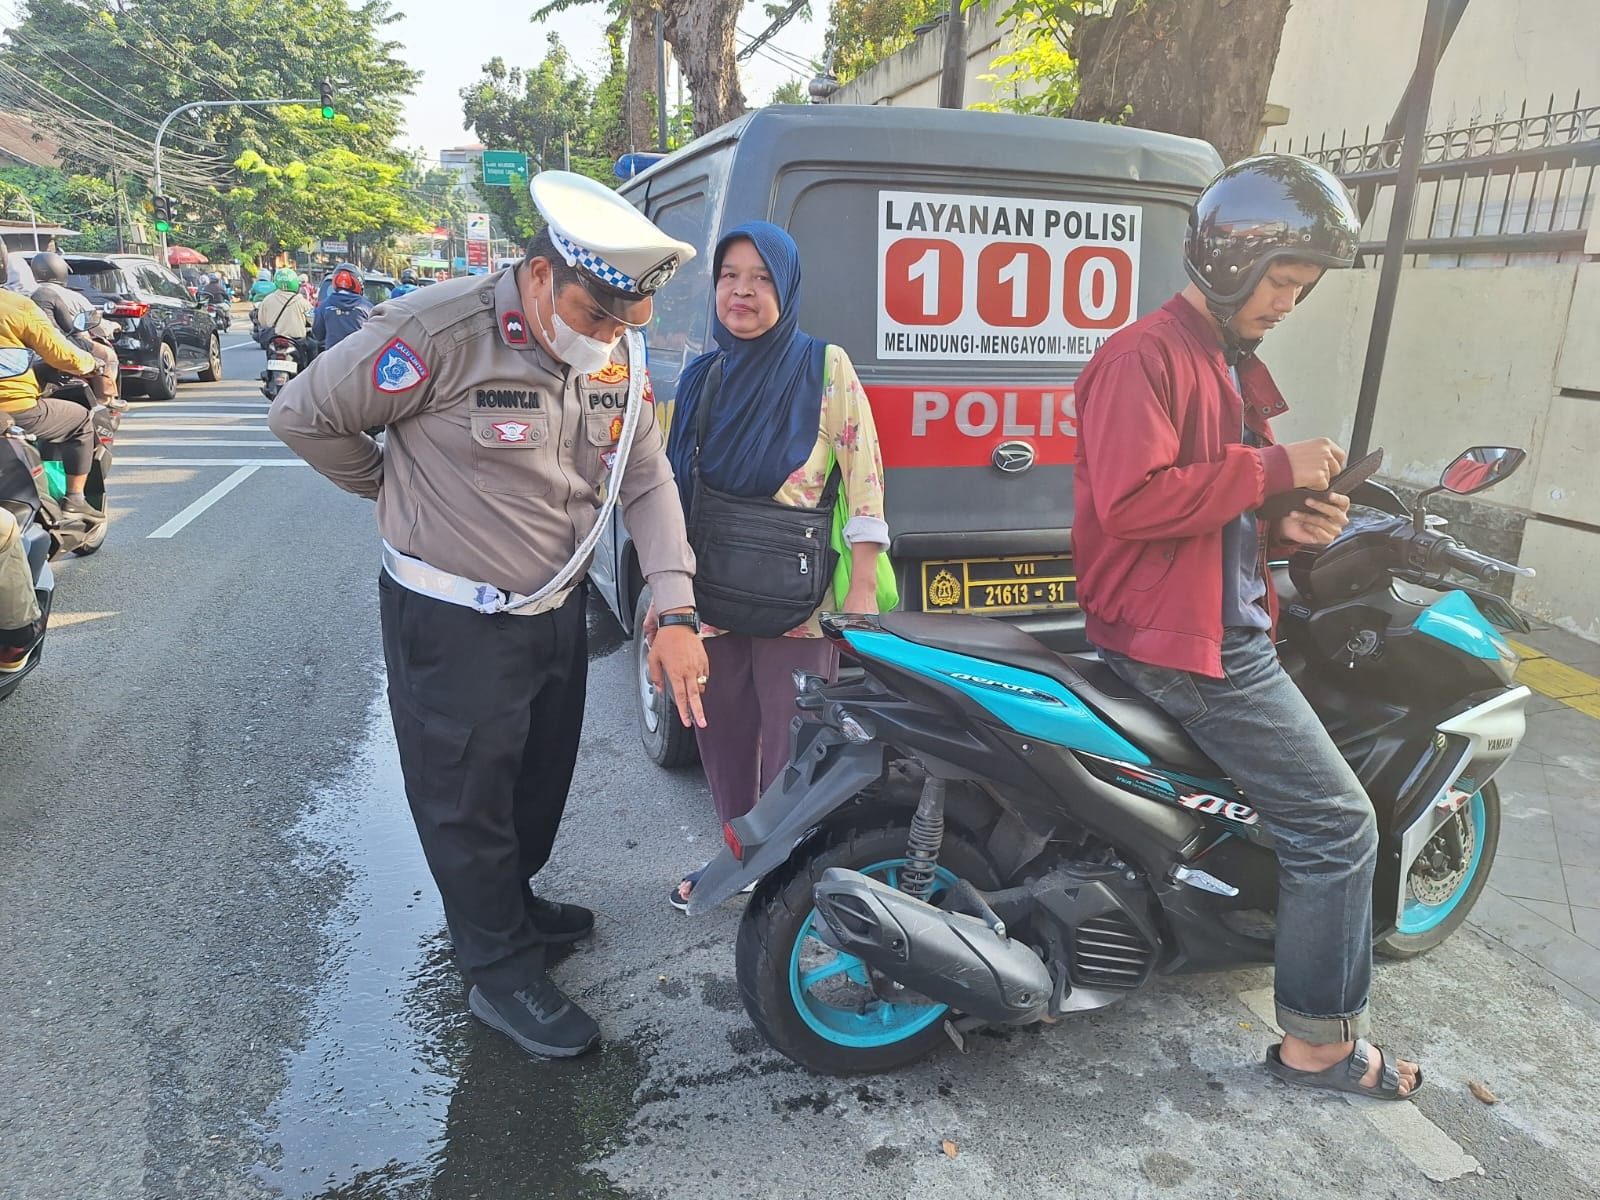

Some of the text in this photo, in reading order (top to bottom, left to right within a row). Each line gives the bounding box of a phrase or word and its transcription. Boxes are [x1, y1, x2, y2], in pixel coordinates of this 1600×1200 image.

[886, 200, 1135, 242] LAYANAN POLISI
[476, 389, 540, 409] RONNY.M
[1014, 562, 1035, 575] VII
[985, 584, 1029, 606] 21613
[1048, 583, 1064, 602] 31
[1487, 737, 1513, 751] YAMAHA
